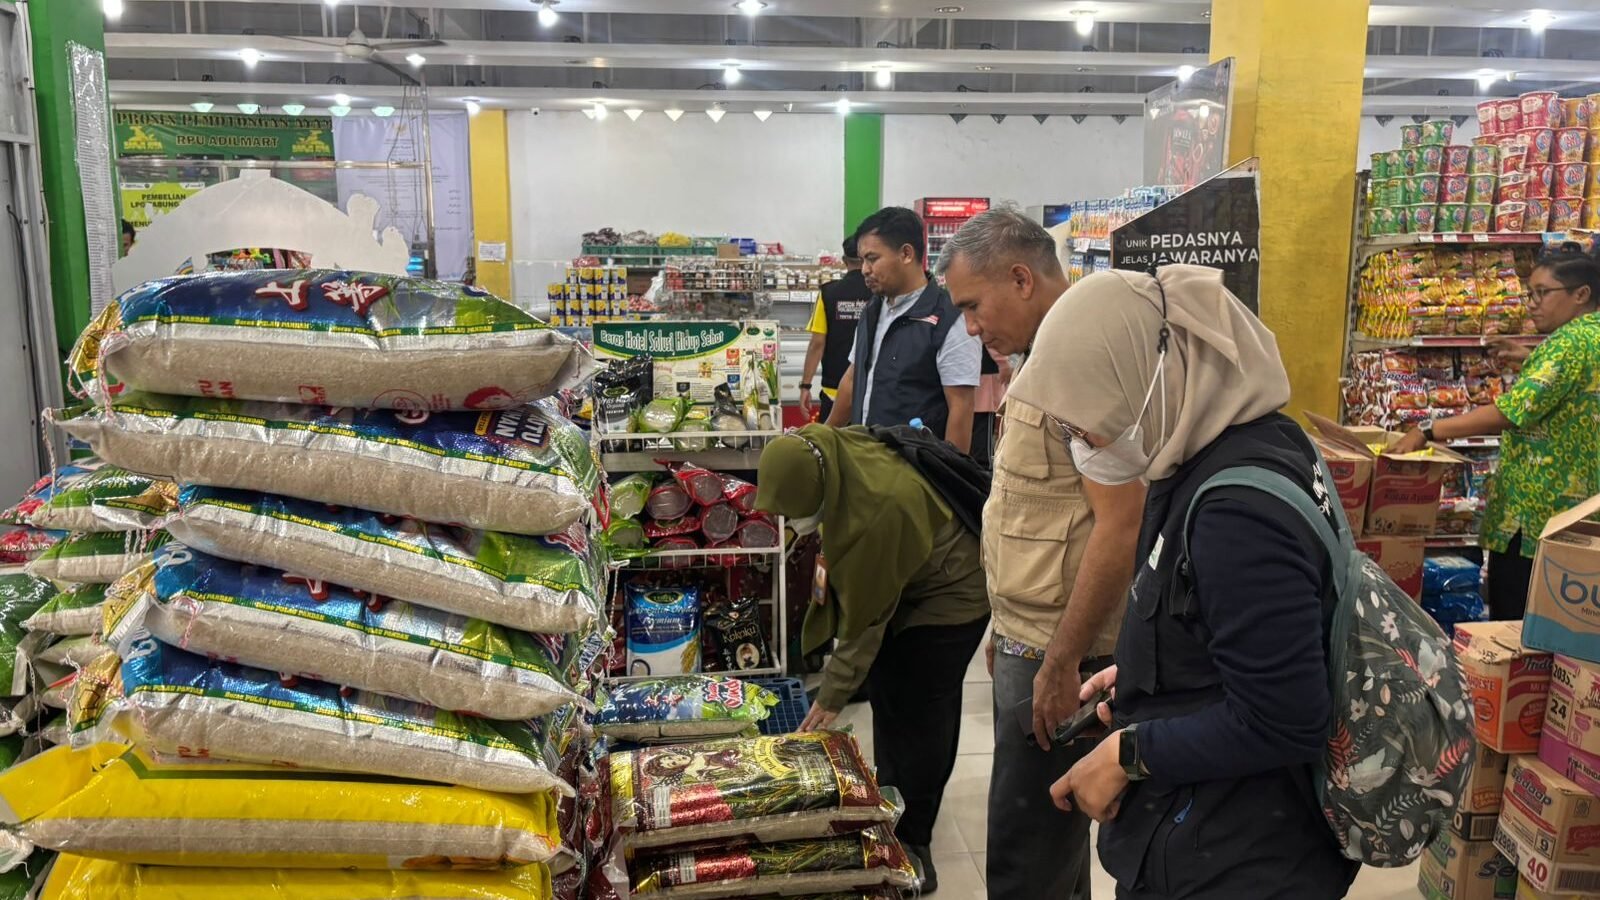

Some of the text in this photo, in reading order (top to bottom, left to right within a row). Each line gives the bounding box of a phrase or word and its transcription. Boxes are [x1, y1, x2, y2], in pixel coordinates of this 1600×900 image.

[117, 112, 176, 126] PROSES
[176, 135, 205, 146] RPU
[208, 135, 279, 148] ADILMART
[1126, 230, 1243, 249] UNIK PEDASNYA
[1121, 247, 1259, 266] JELAS JAWARANYA
[600, 330, 624, 347] Beras
[625, 329, 648, 352] Hotel
[675, 330, 699, 353] Hidup
[701, 329, 725, 347] Sehat
[1550, 698, 1567, 720] 24
[1511, 764, 1552, 806] Sedaap
[1540, 839, 1549, 852] 9
[1527, 856, 1548, 883] 40
